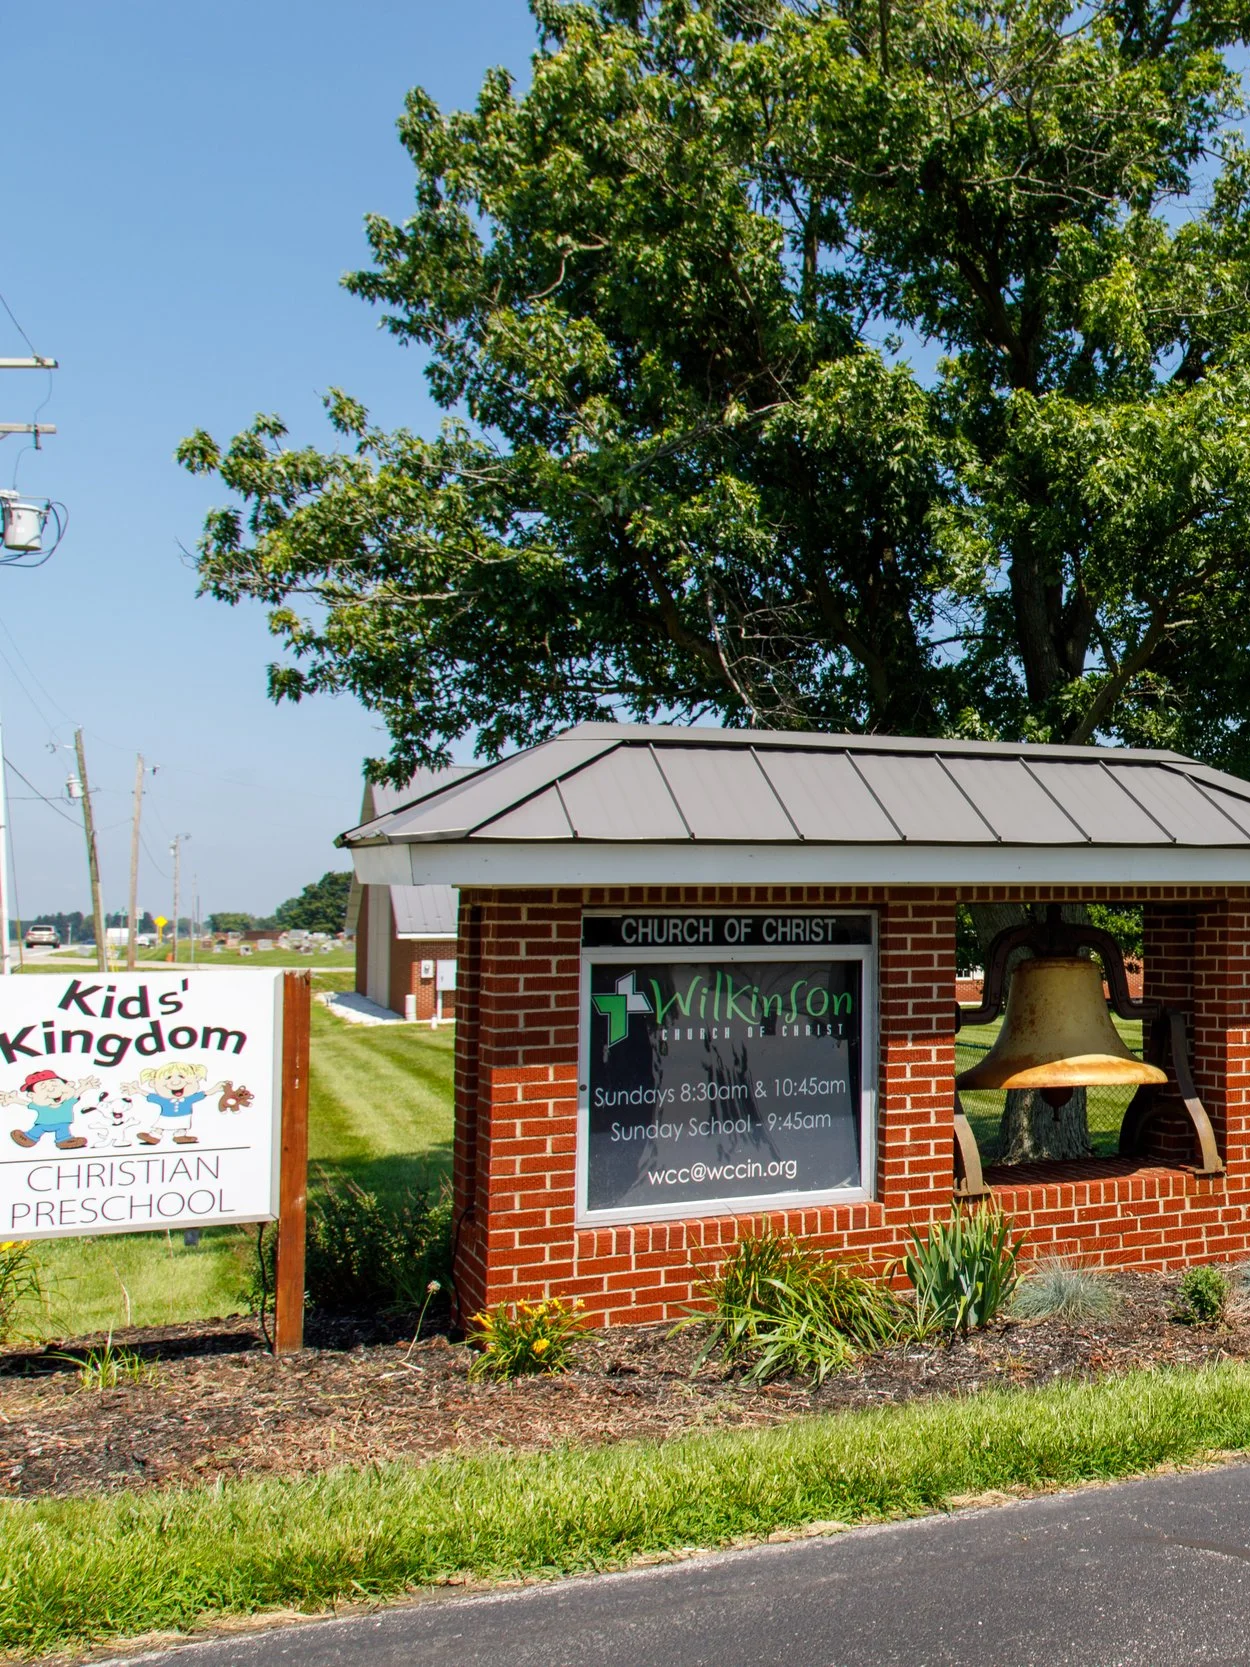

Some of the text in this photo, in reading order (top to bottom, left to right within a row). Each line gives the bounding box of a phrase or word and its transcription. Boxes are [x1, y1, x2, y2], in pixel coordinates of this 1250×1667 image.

[621, 917, 836, 943] CHURCH OF CHRIST
[58, 978, 188, 1019] Kids'
[649, 970, 853, 1025] Wilkinson
[0, 1020, 248, 1068] Kingdom
[661, 1023, 844, 1041] CHURCH OF CHRIST
[594, 1077, 847, 1108] Sundays 8:30am & 10:45am
[610, 1123, 684, 1142] Sunday
[688, 1117, 751, 1137] School
[767, 1112, 832, 1132] 9:45am
[27, 1156, 219, 1192] CHRISTIAN
[648, 1158, 798, 1185] wcc@wccin.org
[11, 1189, 235, 1229] PRESCHOOL
